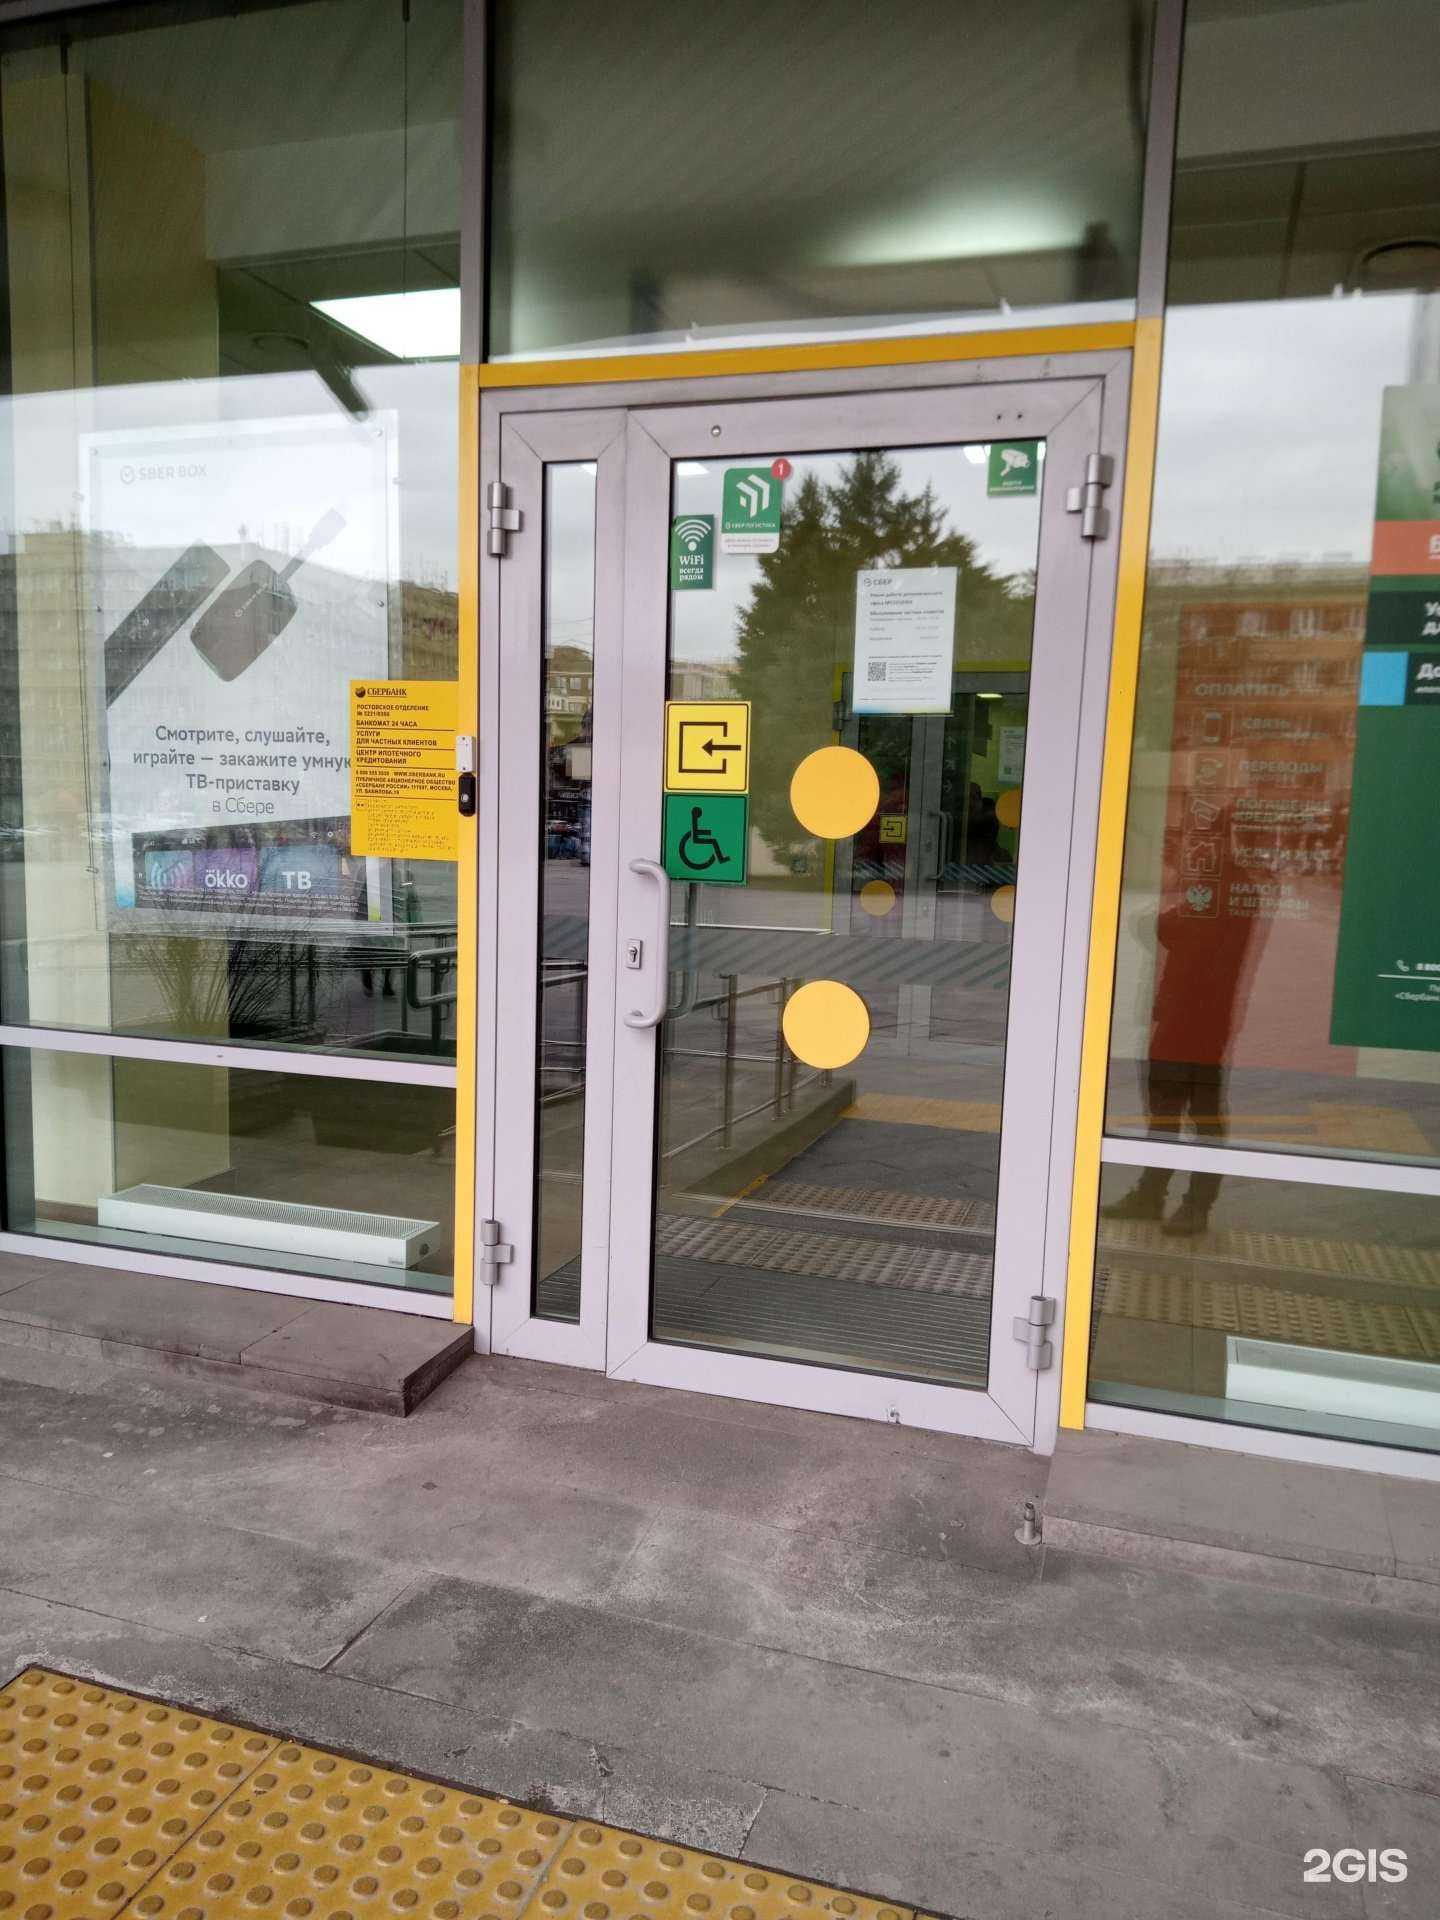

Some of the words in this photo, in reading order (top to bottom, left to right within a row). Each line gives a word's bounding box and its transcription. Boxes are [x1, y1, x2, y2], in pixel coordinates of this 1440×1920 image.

[138, 467, 174, 480] SBER
[178, 464, 207, 478] BOX
[778, 463, 784, 475] 1
[679, 554, 704, 565] WiFi
[367, 687, 407, 696] СБЕРБАНК
[356, 719, 390, 727] БАНКОМАТ
[155, 725, 239, 744] Смотрите,
[245, 727, 330, 746] слушайте,
[133, 748, 195, 767] играйте
[219, 753, 297, 767] закажите
[378, 750, 421, 758] ИПОТЕЧНОГО
[185, 774, 300, 795] ТВ-приставку
[212, 800, 221, 812] в
[225, 797, 275, 816] Сбере
